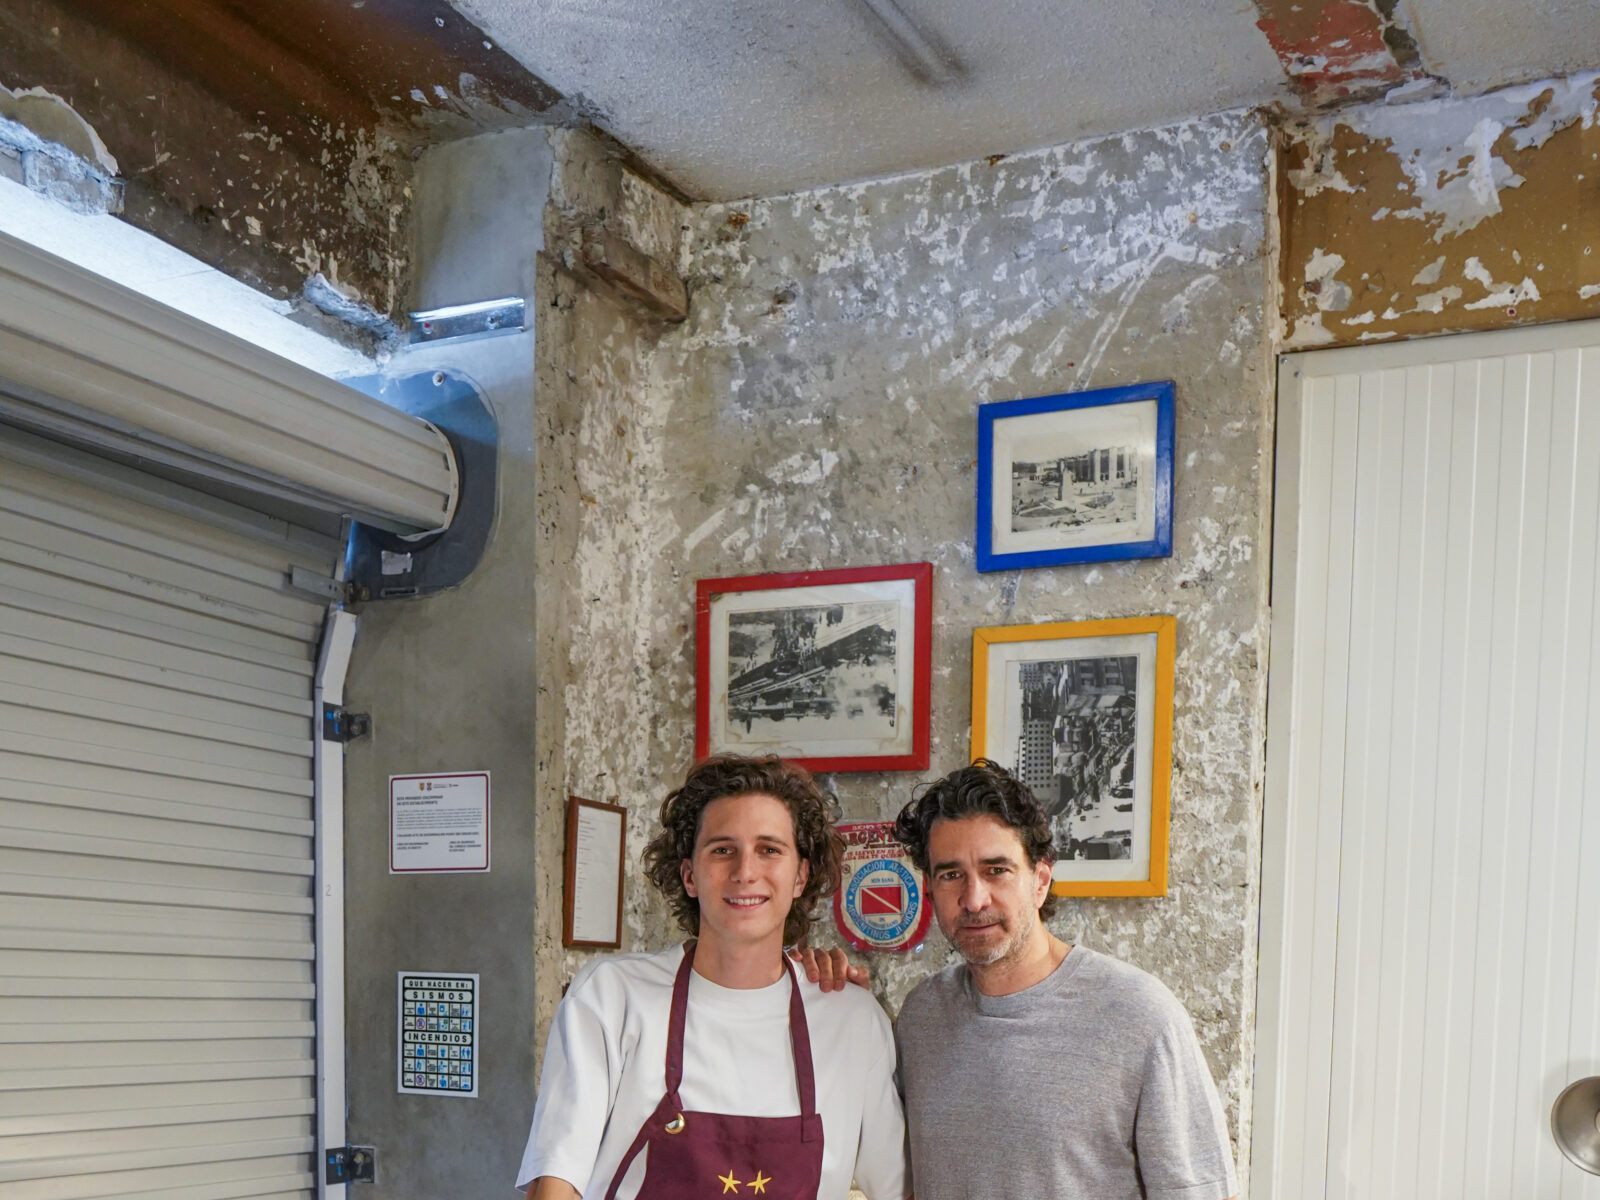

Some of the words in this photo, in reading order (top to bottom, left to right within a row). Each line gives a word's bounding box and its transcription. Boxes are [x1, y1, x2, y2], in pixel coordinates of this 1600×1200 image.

[841, 829, 894, 846] ARGENT
[851, 861, 886, 893] ASOCIACION
[409, 980, 424, 988] QUE
[412, 991, 464, 1001] SISMOS
[408, 1032, 467, 1043] INCENDIOS
